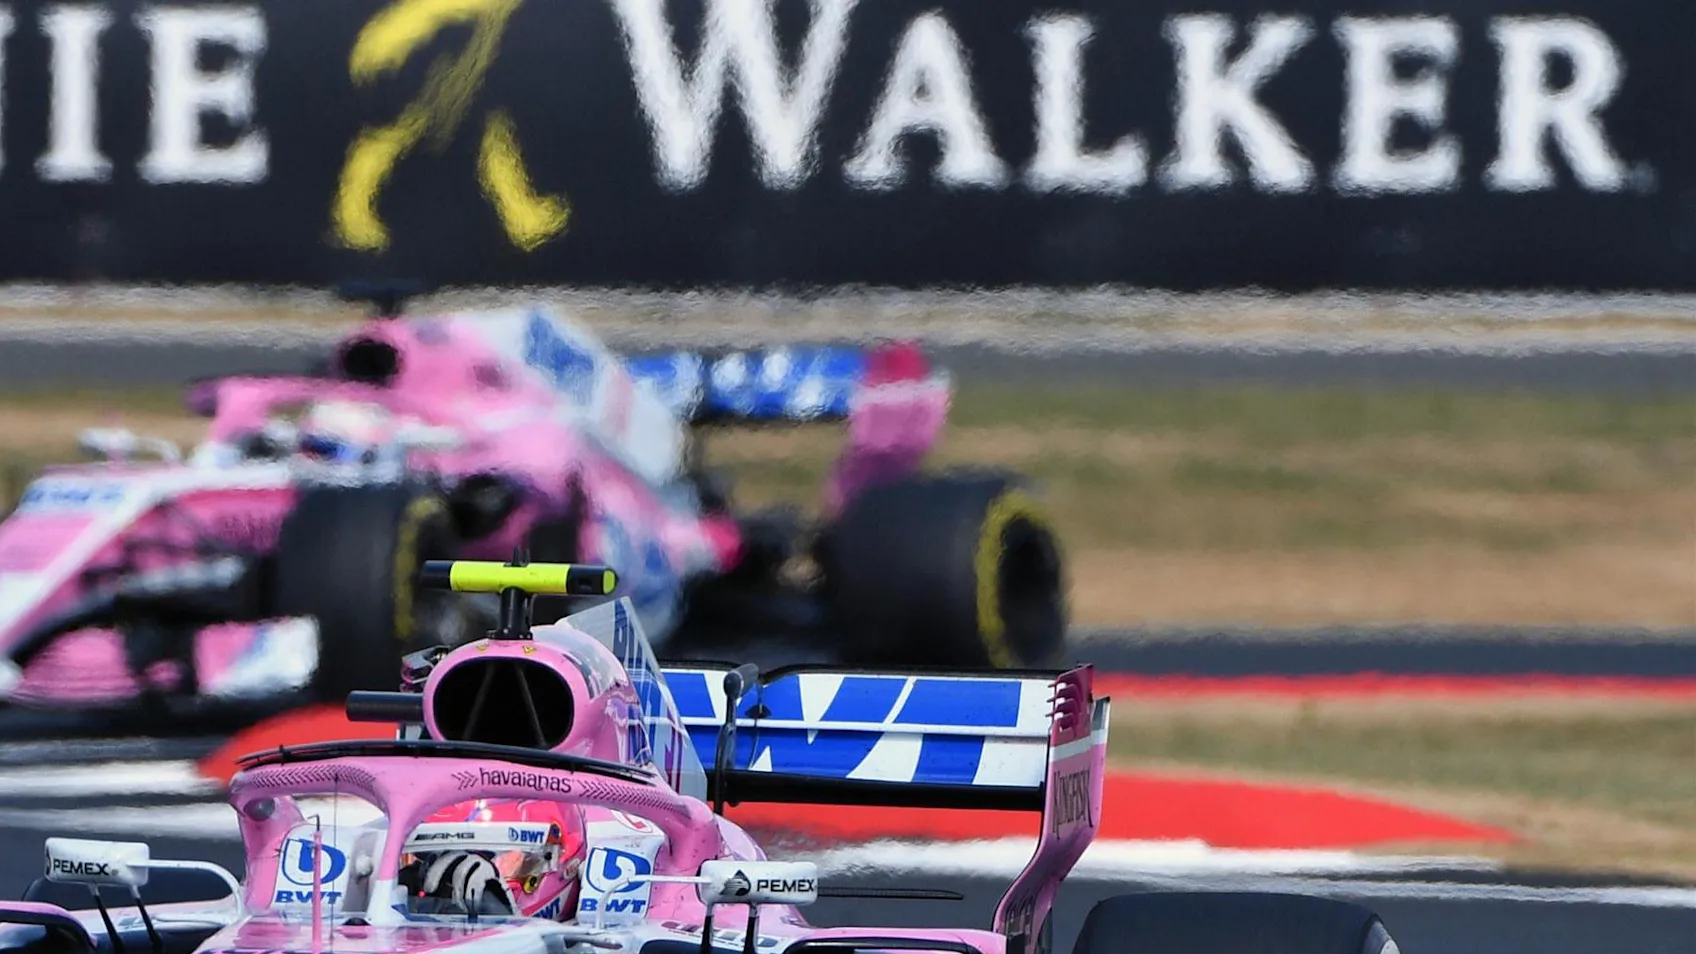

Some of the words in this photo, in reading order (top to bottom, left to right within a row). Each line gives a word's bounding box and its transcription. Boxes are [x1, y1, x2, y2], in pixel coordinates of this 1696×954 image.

[612, 0, 1630, 193] WALKER
[478, 767, 573, 793] havaianas
[520, 830, 545, 843] BWT
[53, 859, 110, 876] PEMEX
[757, 879, 815, 893] PEMEX
[275, 890, 343, 905] BWT
[579, 898, 646, 913] BWT
